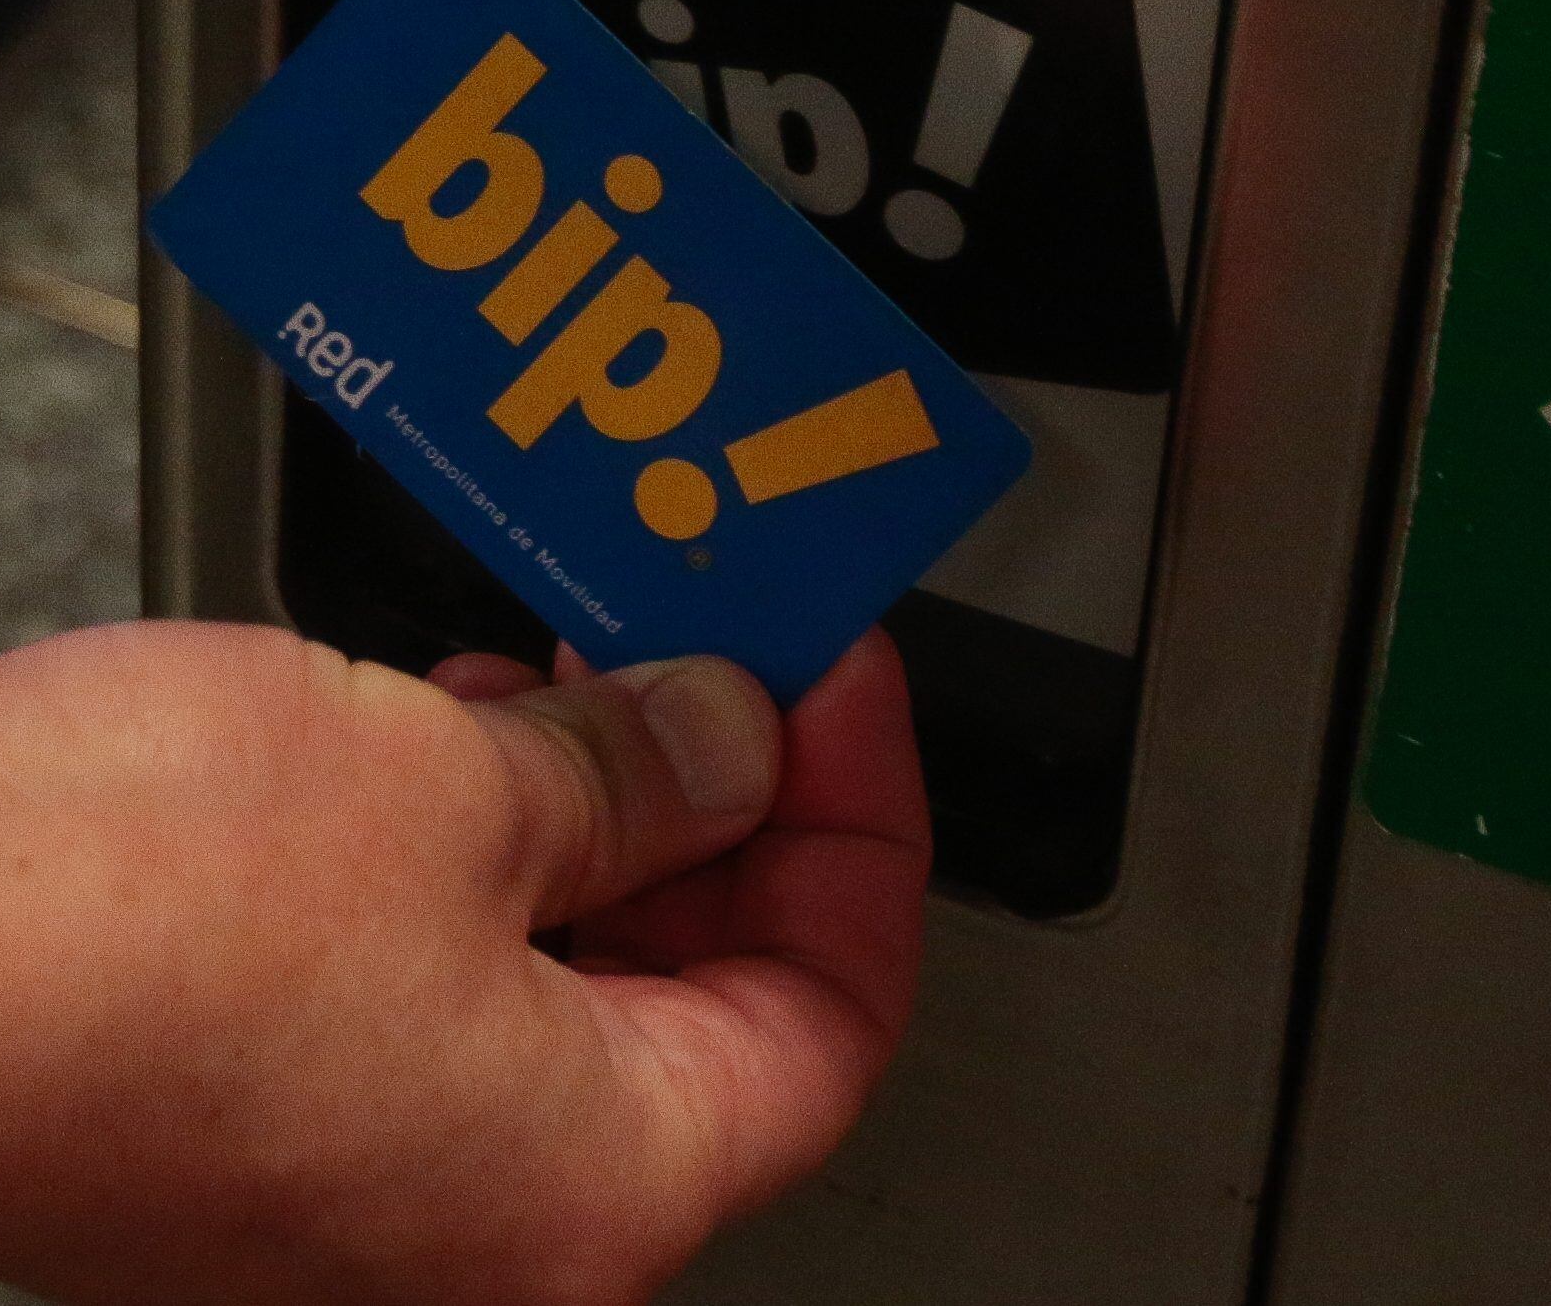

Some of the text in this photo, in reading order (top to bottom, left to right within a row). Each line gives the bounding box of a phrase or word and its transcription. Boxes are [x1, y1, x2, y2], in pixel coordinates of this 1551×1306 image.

[276, 301, 625, 636] Red Metropolitana de Movilidad
[357, 29, 942, 542] bip!
